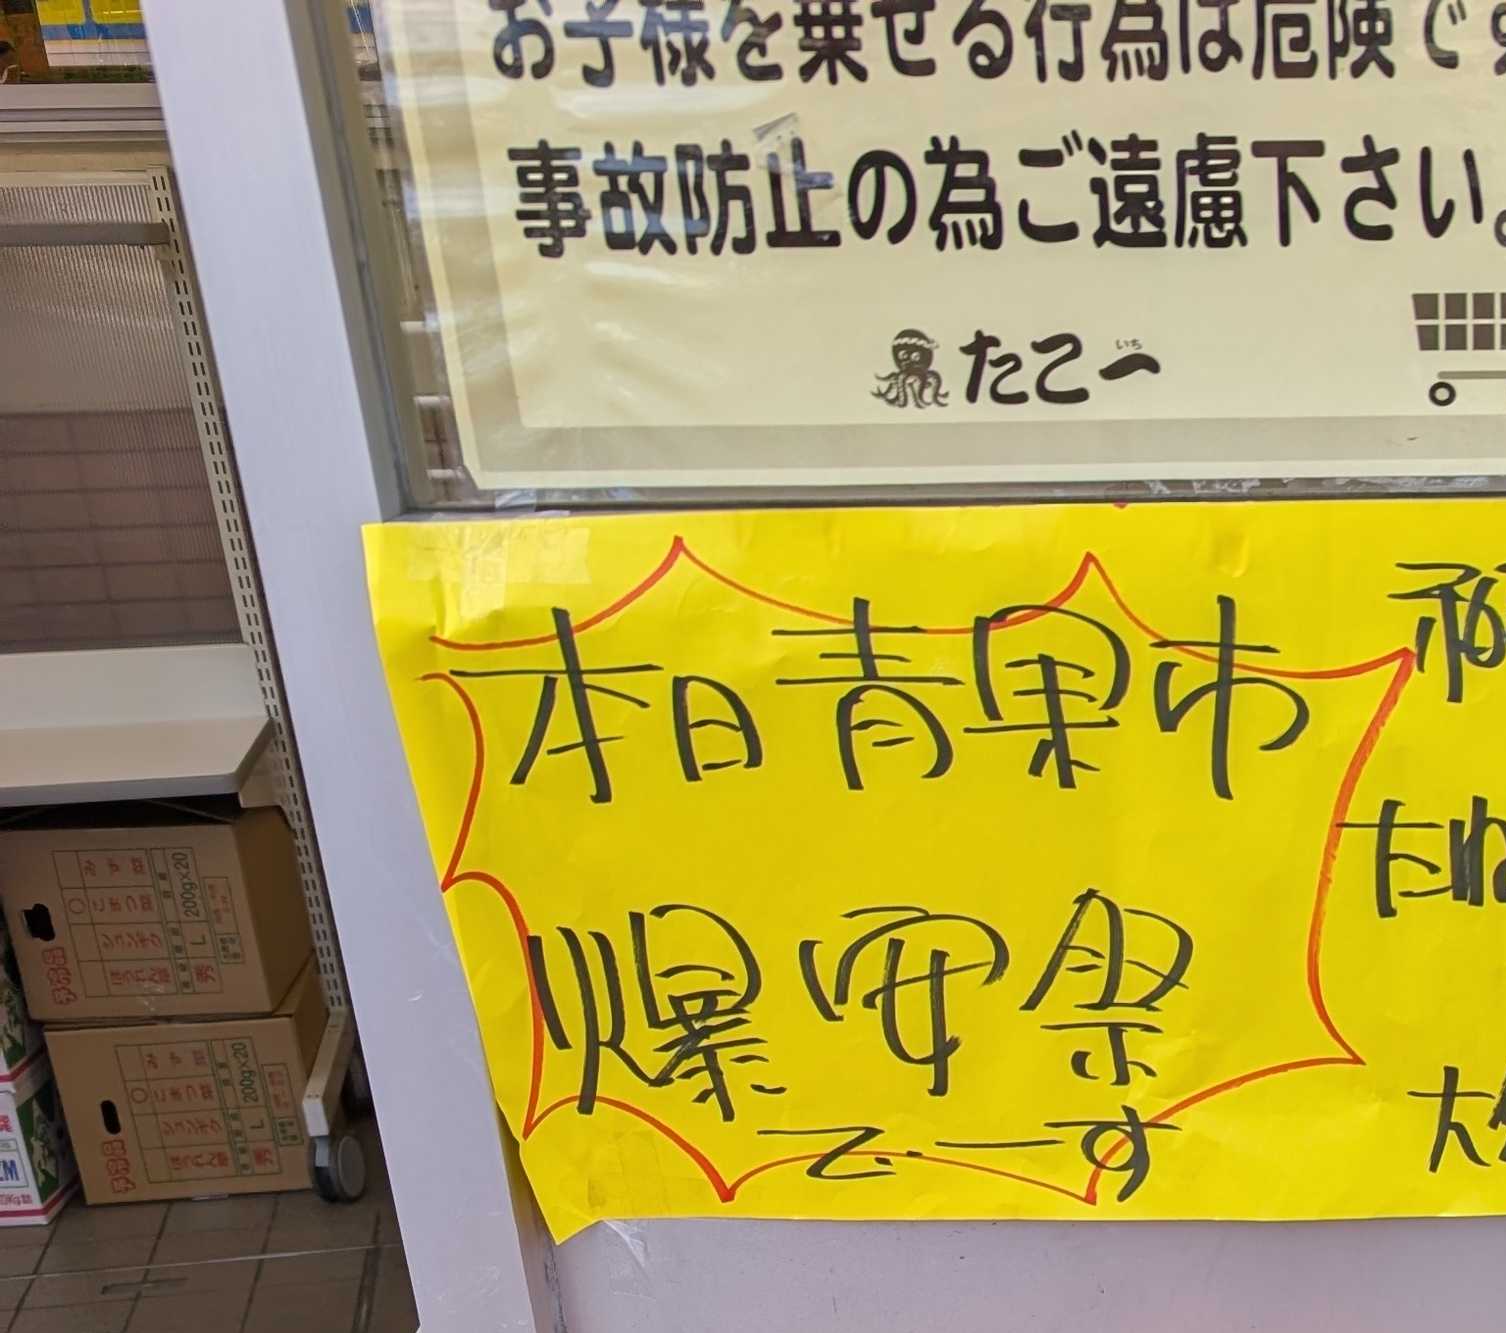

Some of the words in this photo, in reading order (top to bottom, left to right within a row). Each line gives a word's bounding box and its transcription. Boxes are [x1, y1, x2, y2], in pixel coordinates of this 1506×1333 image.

[450, 595, 1311, 804] 本日青果市
[527, 887, 1194, 1122] 爆安祭
